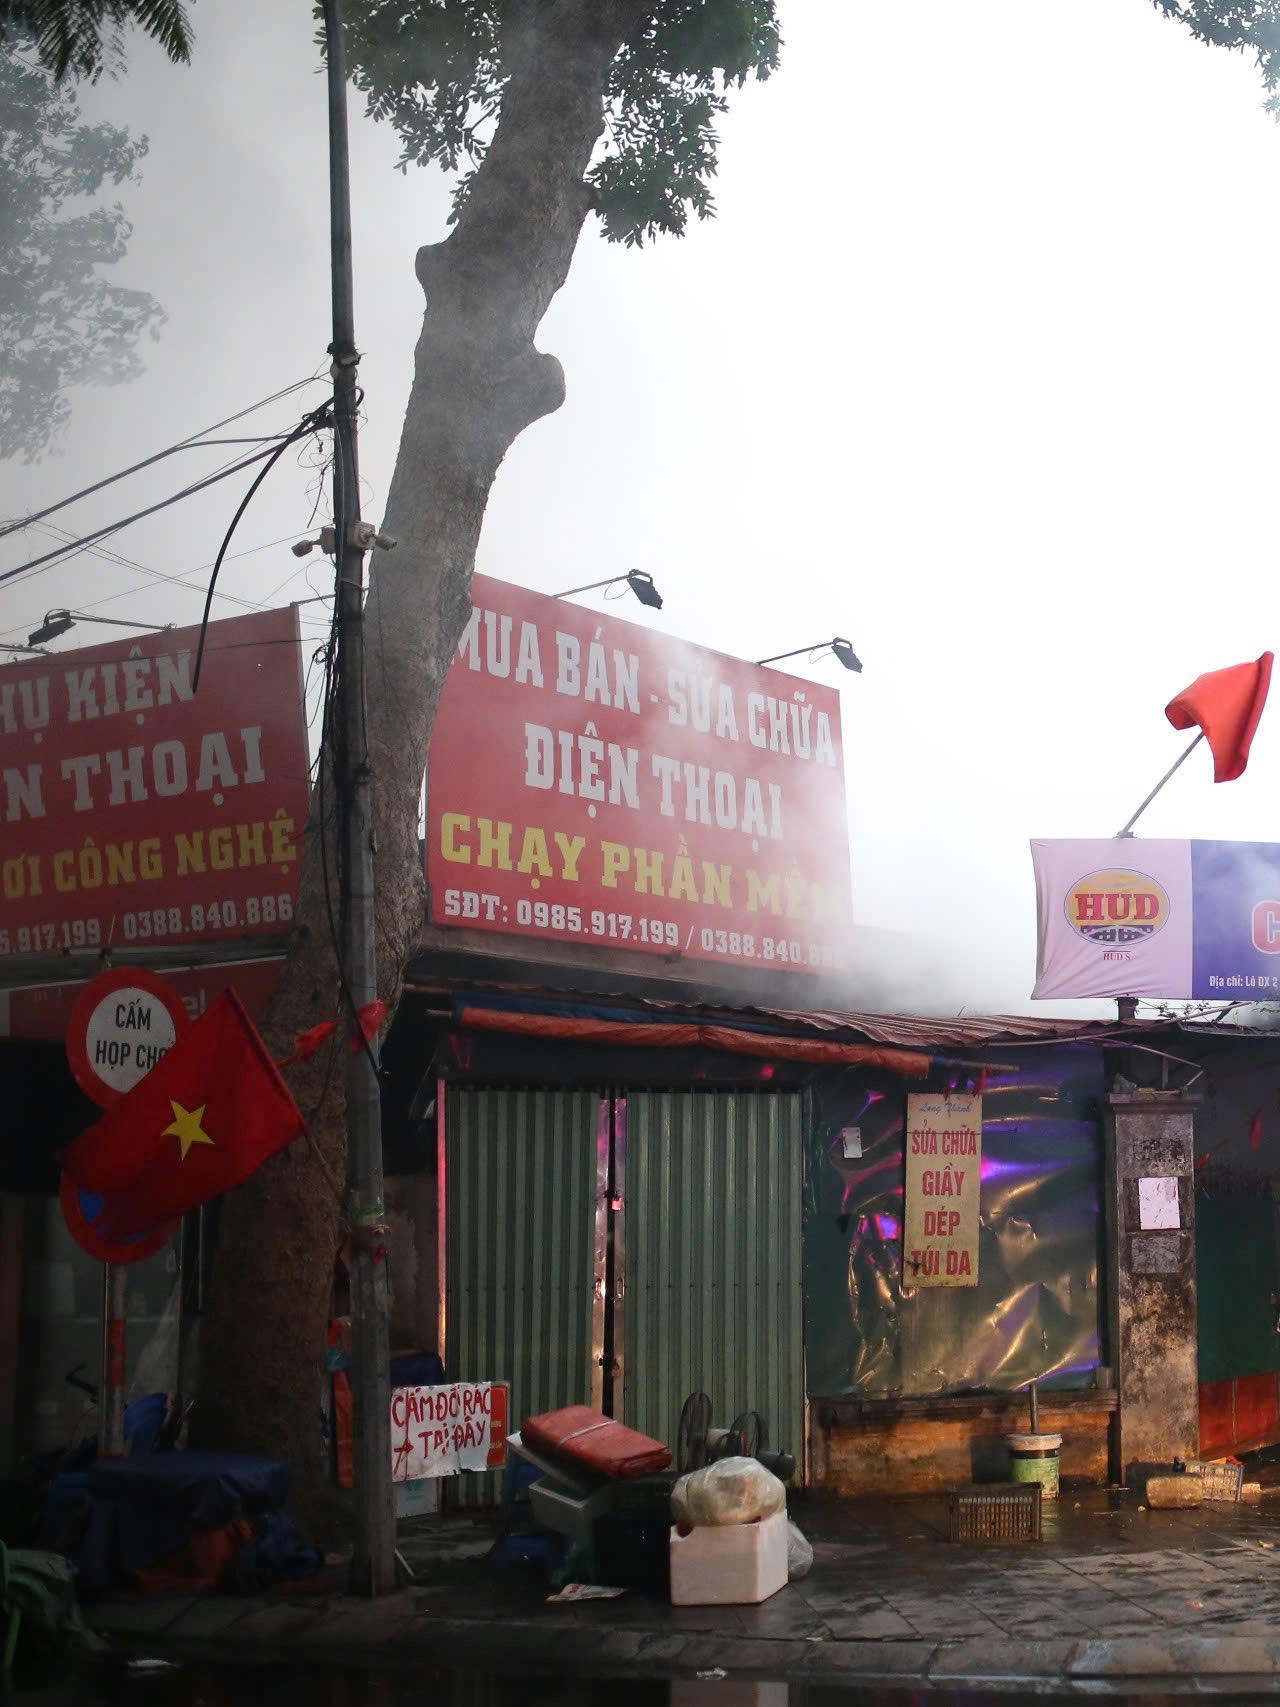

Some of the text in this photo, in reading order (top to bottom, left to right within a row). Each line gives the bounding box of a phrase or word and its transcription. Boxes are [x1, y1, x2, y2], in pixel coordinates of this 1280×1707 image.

[65, 645, 197, 726] KIỆN
[555, 626, 641, 714] BÁN
[747, 690, 837, 767] CHỮA
[61, 726, 266, 812] THOẠI
[524, 720, 784, 852] ĐIỆN THOẠI
[53, 836, 163, 893] CÔNG
[176, 807, 298, 875] NGHỆ
[440, 812, 586, 889] CHẠY
[601, 833, 735, 909] PHẦN
[123, 893, 294, 941] 0388.840.886
[444, 888, 508, 923] SĐT:
[516, 898, 679, 947] 0985.917.199
[1074, 893, 1160, 921] HUD
[1209, 975, 1224, 989] Địa
[115, 998, 152, 1031] CẤM
[95, 1039, 131, 1070] HỌP
[911, 1119, 977, 1156] SỬA CHỮA
[923, 1205, 961, 1237] DÉP
[911, 1245, 971, 1276] TÚI DA
[463, 1384, 491, 1416] RÁC
[451, 1415, 486, 1452] ĐÂY
